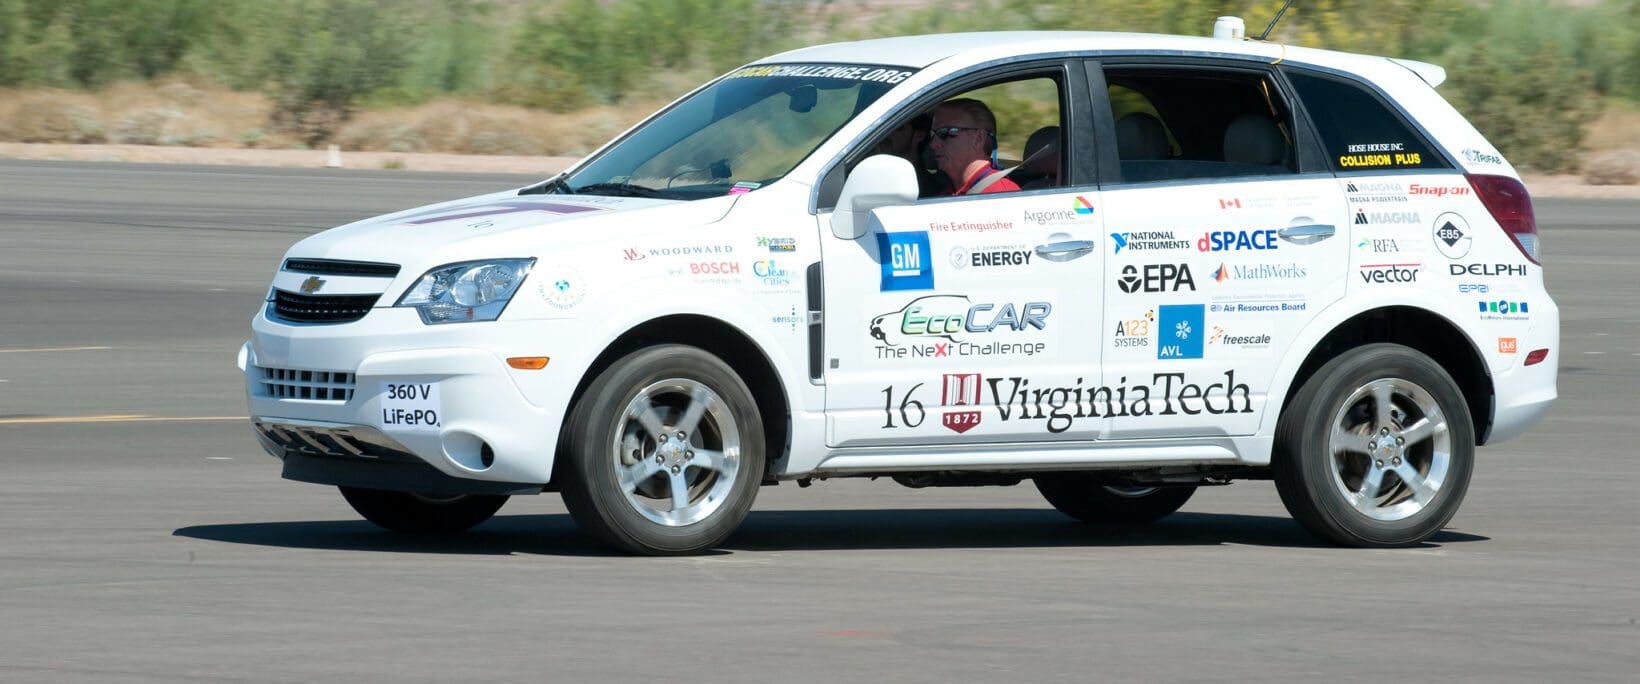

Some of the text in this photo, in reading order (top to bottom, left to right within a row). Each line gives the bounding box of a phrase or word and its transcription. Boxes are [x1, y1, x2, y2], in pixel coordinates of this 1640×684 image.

[1348, 145, 1366, 153] HOSE
[1367, 144, 1390, 152] HOUSE
[1340, 153, 1421, 167] COLLISION PLUS
[1361, 182, 1403, 193] MAGNA
[1408, 184, 1470, 197] Snap-on
[1024, 209, 1075, 225] Argonne
[1370, 211, 1421, 225] MAGNA
[930, 221, 1013, 233] Fire Extinguisher
[1440, 229, 1460, 239] E85
[1129, 231, 1190, 250] NATIONAL INSTRUMENTS
[1197, 229, 1278, 252] dSPACE
[1373, 238, 1399, 253] RFA
[649, 245, 733, 256] WOODWARD
[891, 243, 920, 269] GM
[972, 250, 1032, 267] ENERGY
[690, 261, 740, 275] BOSCH
[753, 260, 789, 278] Clean
[1233, 262, 1307, 280] MathWorks
[1360, 264, 1419, 284] vector
[1449, 263, 1527, 276] DELPHI
[763, 276, 790, 286] Cities
[1143, 263, 1197, 293] EPA
[1223, 302, 1306, 312] Air Resources Board
[901, 302, 1053, 336] EcoCAR
[1115, 320, 1149, 337] A123
[1114, 337, 1149, 348] SYSTEMS
[1223, 333, 1271, 345] freescale
[875, 341, 1045, 359] The NeXt Challenge
[1160, 345, 1184, 357] AVL
[388, 384, 431, 400] 360 V
[881, 382, 927, 429] 16
[945, 413, 979, 425] 1872
